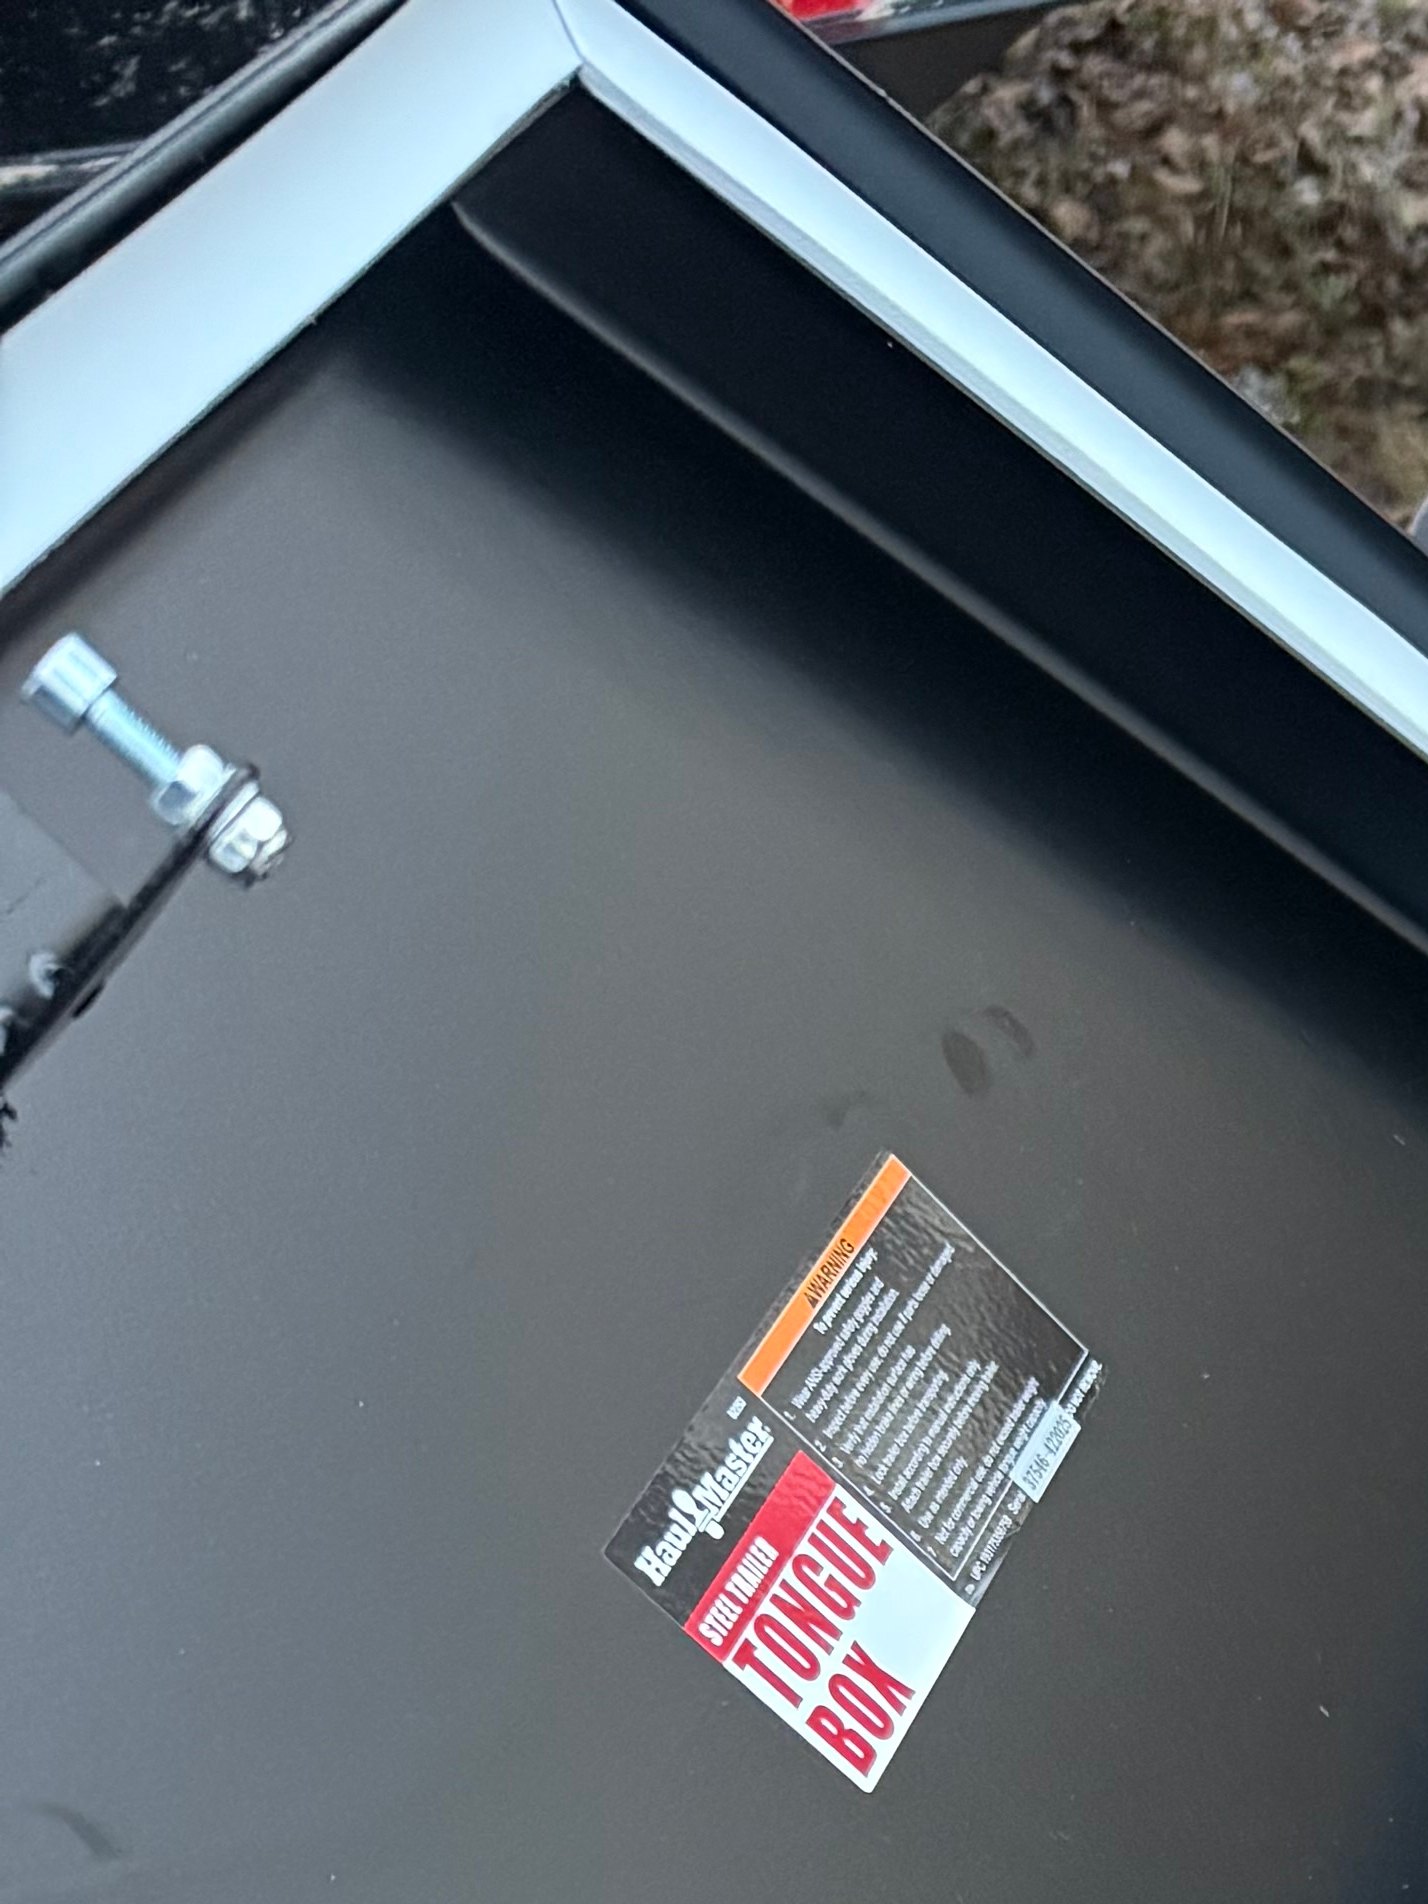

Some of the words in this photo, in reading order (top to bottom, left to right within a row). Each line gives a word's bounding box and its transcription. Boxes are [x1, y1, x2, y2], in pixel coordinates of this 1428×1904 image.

[807, 1237, 854, 1299] WARNING
[634, 1507, 697, 1586] Haul
[692, 1416, 768, 1515] Master
[699, 1593, 743, 1646] STEEL
[725, 1536, 779, 1605] TRAILER
[732, 1496, 894, 1709] TONGUE
[805, 1640, 916, 1778] BOX
